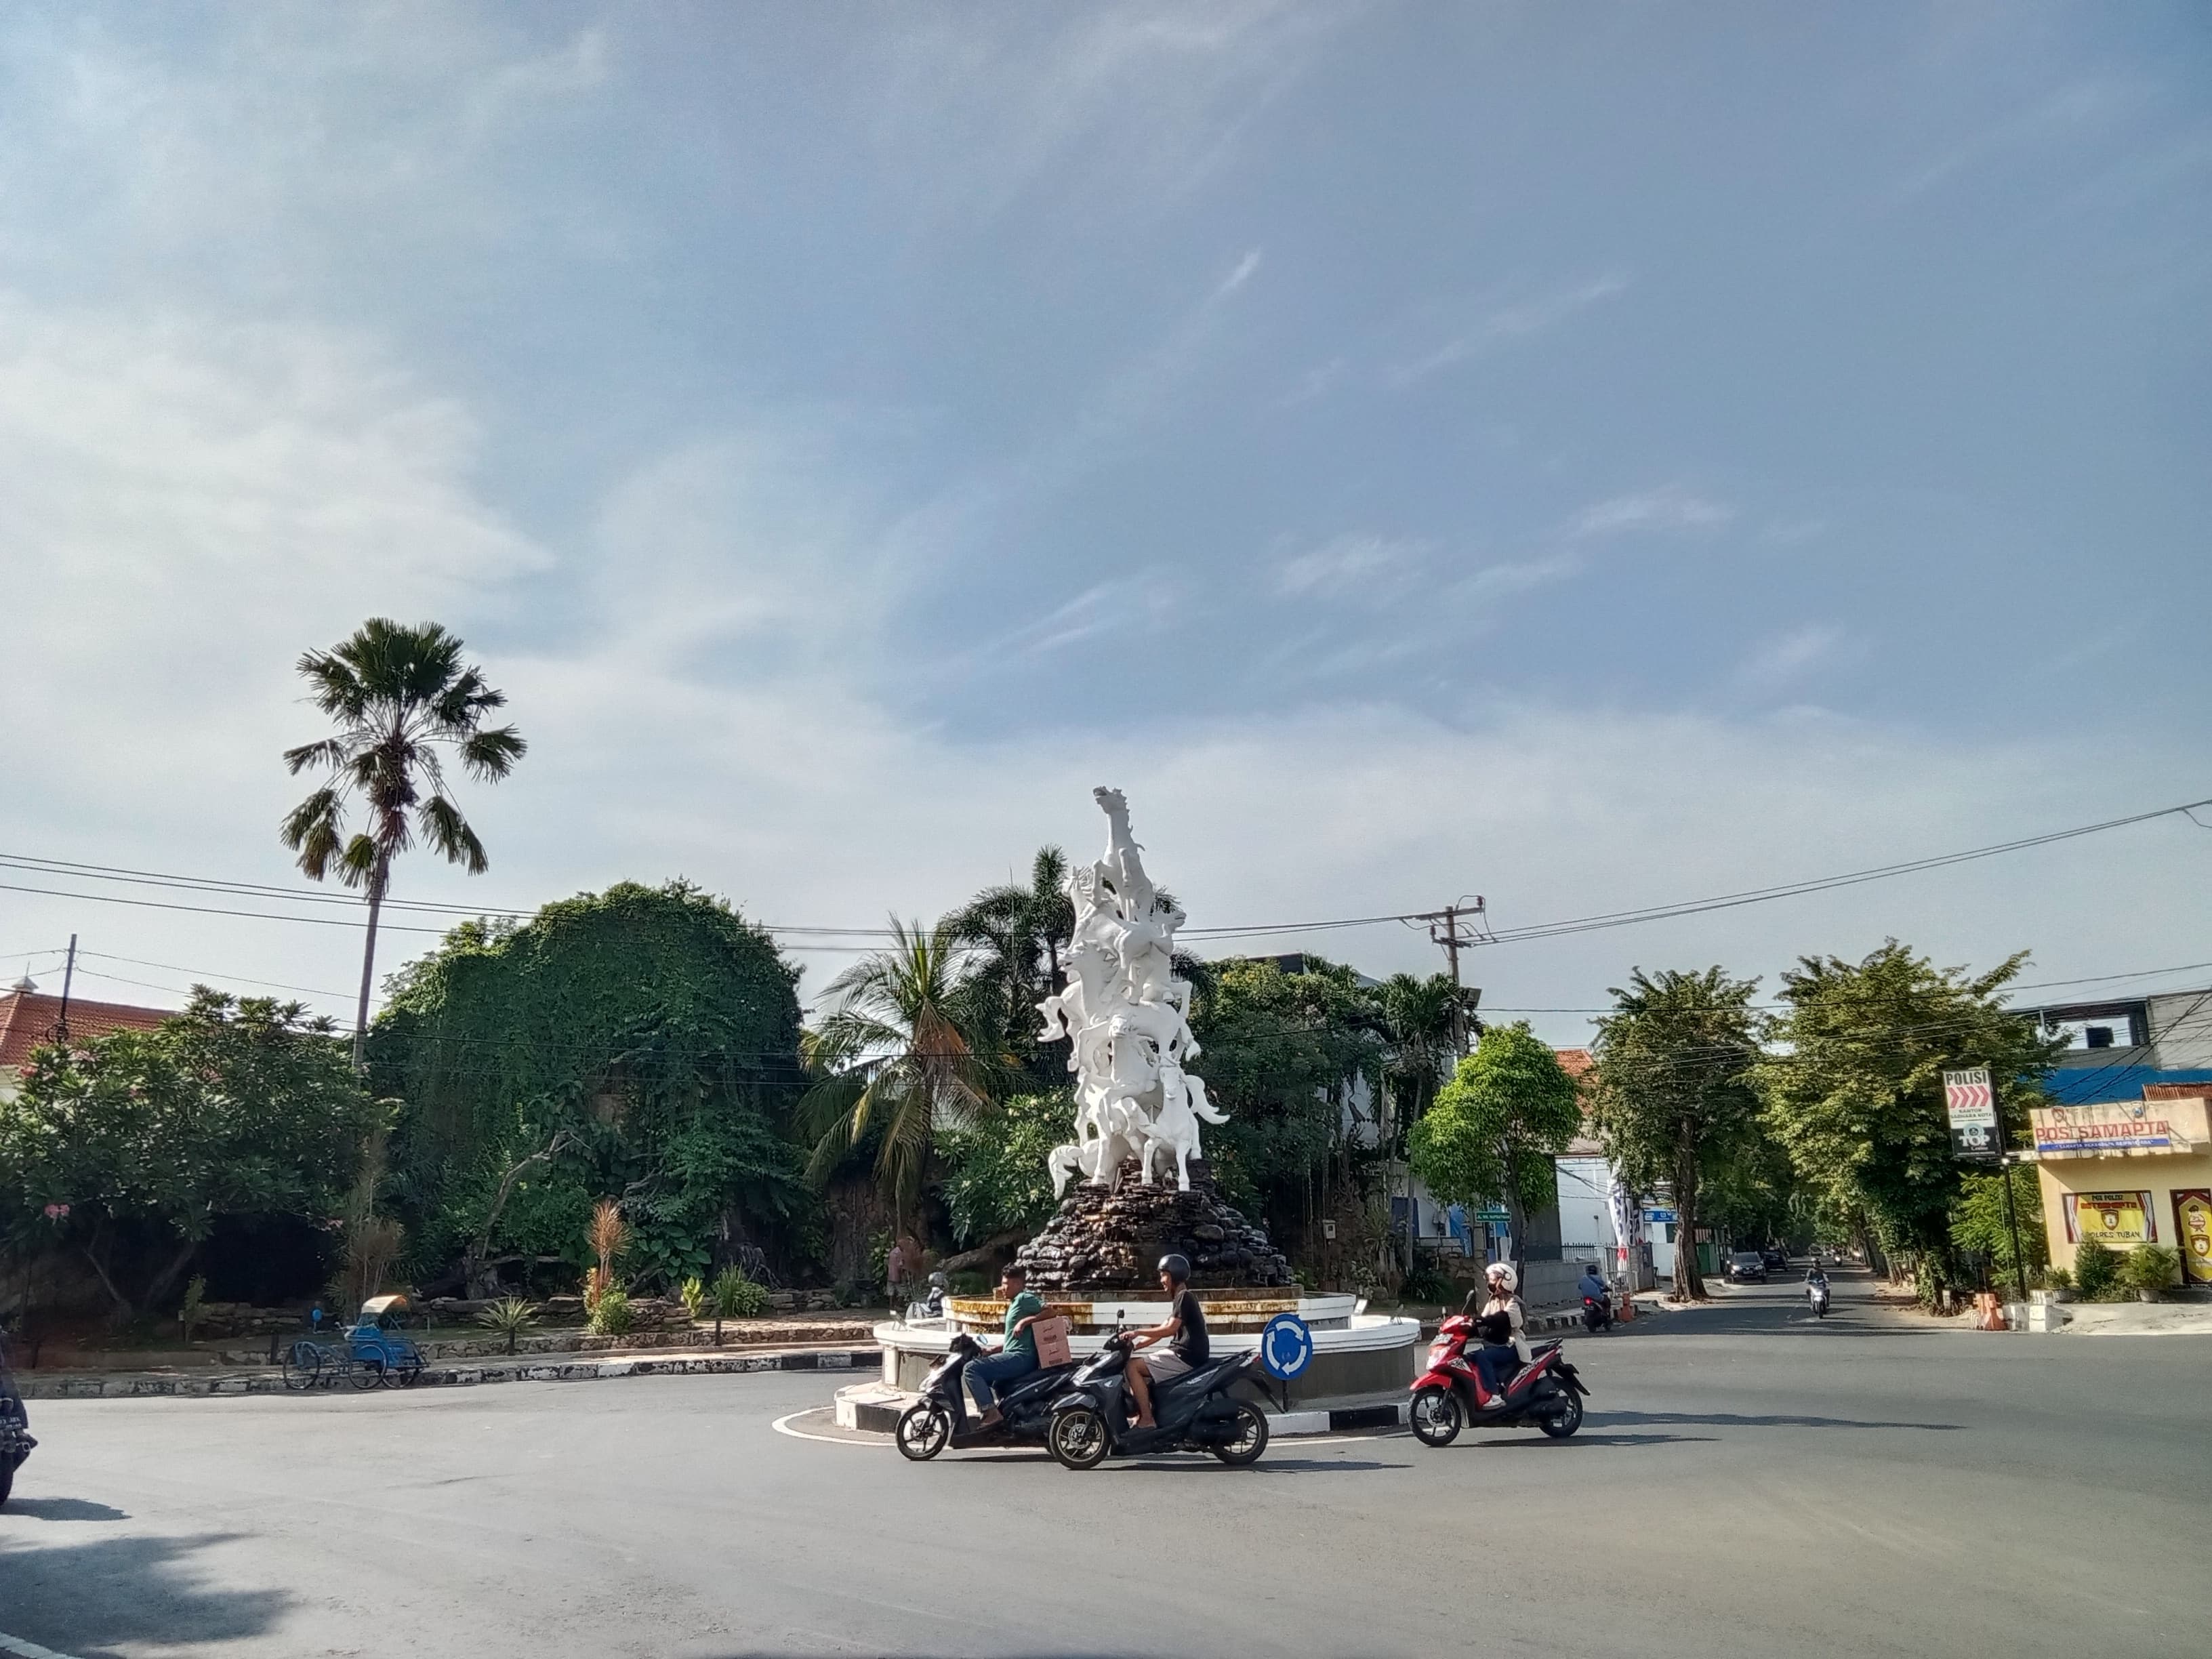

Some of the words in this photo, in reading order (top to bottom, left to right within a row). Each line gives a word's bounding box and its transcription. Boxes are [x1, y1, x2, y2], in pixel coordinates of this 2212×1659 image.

[1946, 1071, 1987, 1086] POLISI
[2036, 1127, 2069, 1140] POS
[2078, 1121, 2168, 1139] SAMAPTA
[1959, 1135, 1990, 1147] TOP
